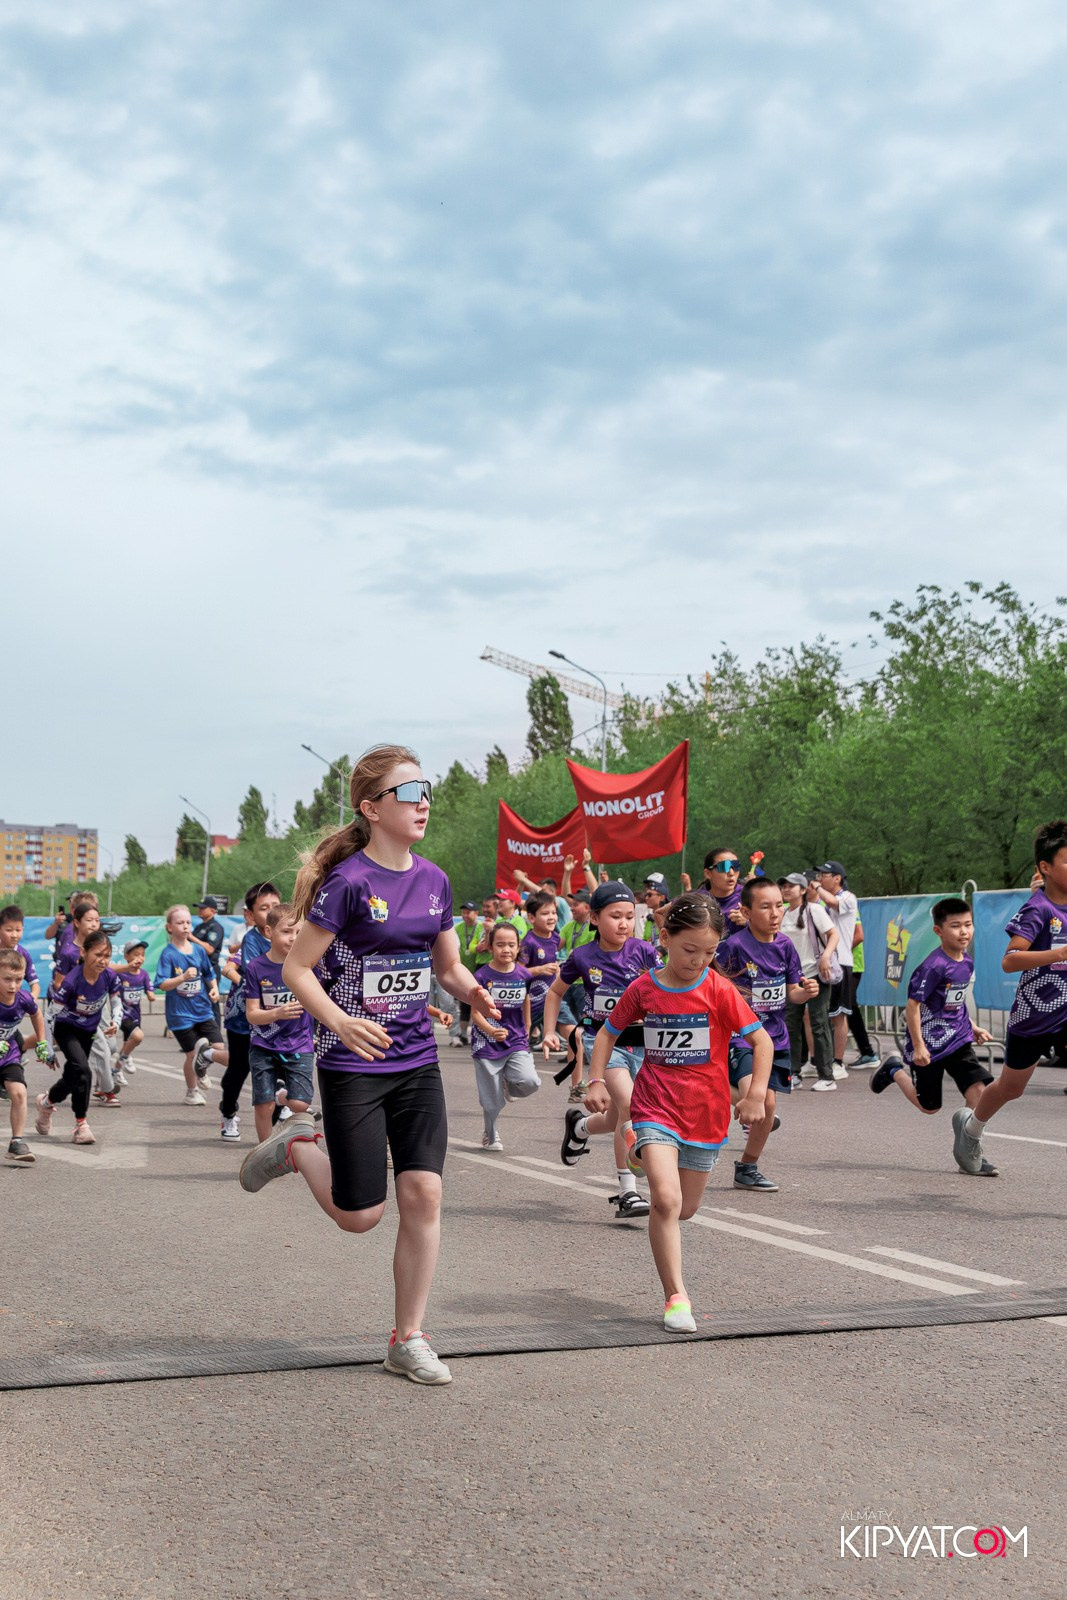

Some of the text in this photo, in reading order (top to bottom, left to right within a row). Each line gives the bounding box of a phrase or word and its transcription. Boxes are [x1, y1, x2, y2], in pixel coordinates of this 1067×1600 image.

[583, 791, 665, 817] MONOLIT
[638, 805, 665, 820] GROUP
[507, 838, 564, 857] MONOLIT
[541, 855, 564, 863] GROUP
[887, 965, 902, 979] RUN
[377, 971, 422, 994] 053
[366, 993, 428, 1005] БАЛАЛАР ЖАРЫСЫ
[498, 989, 521, 999] 056
[657, 1030, 694, 1049] 172
